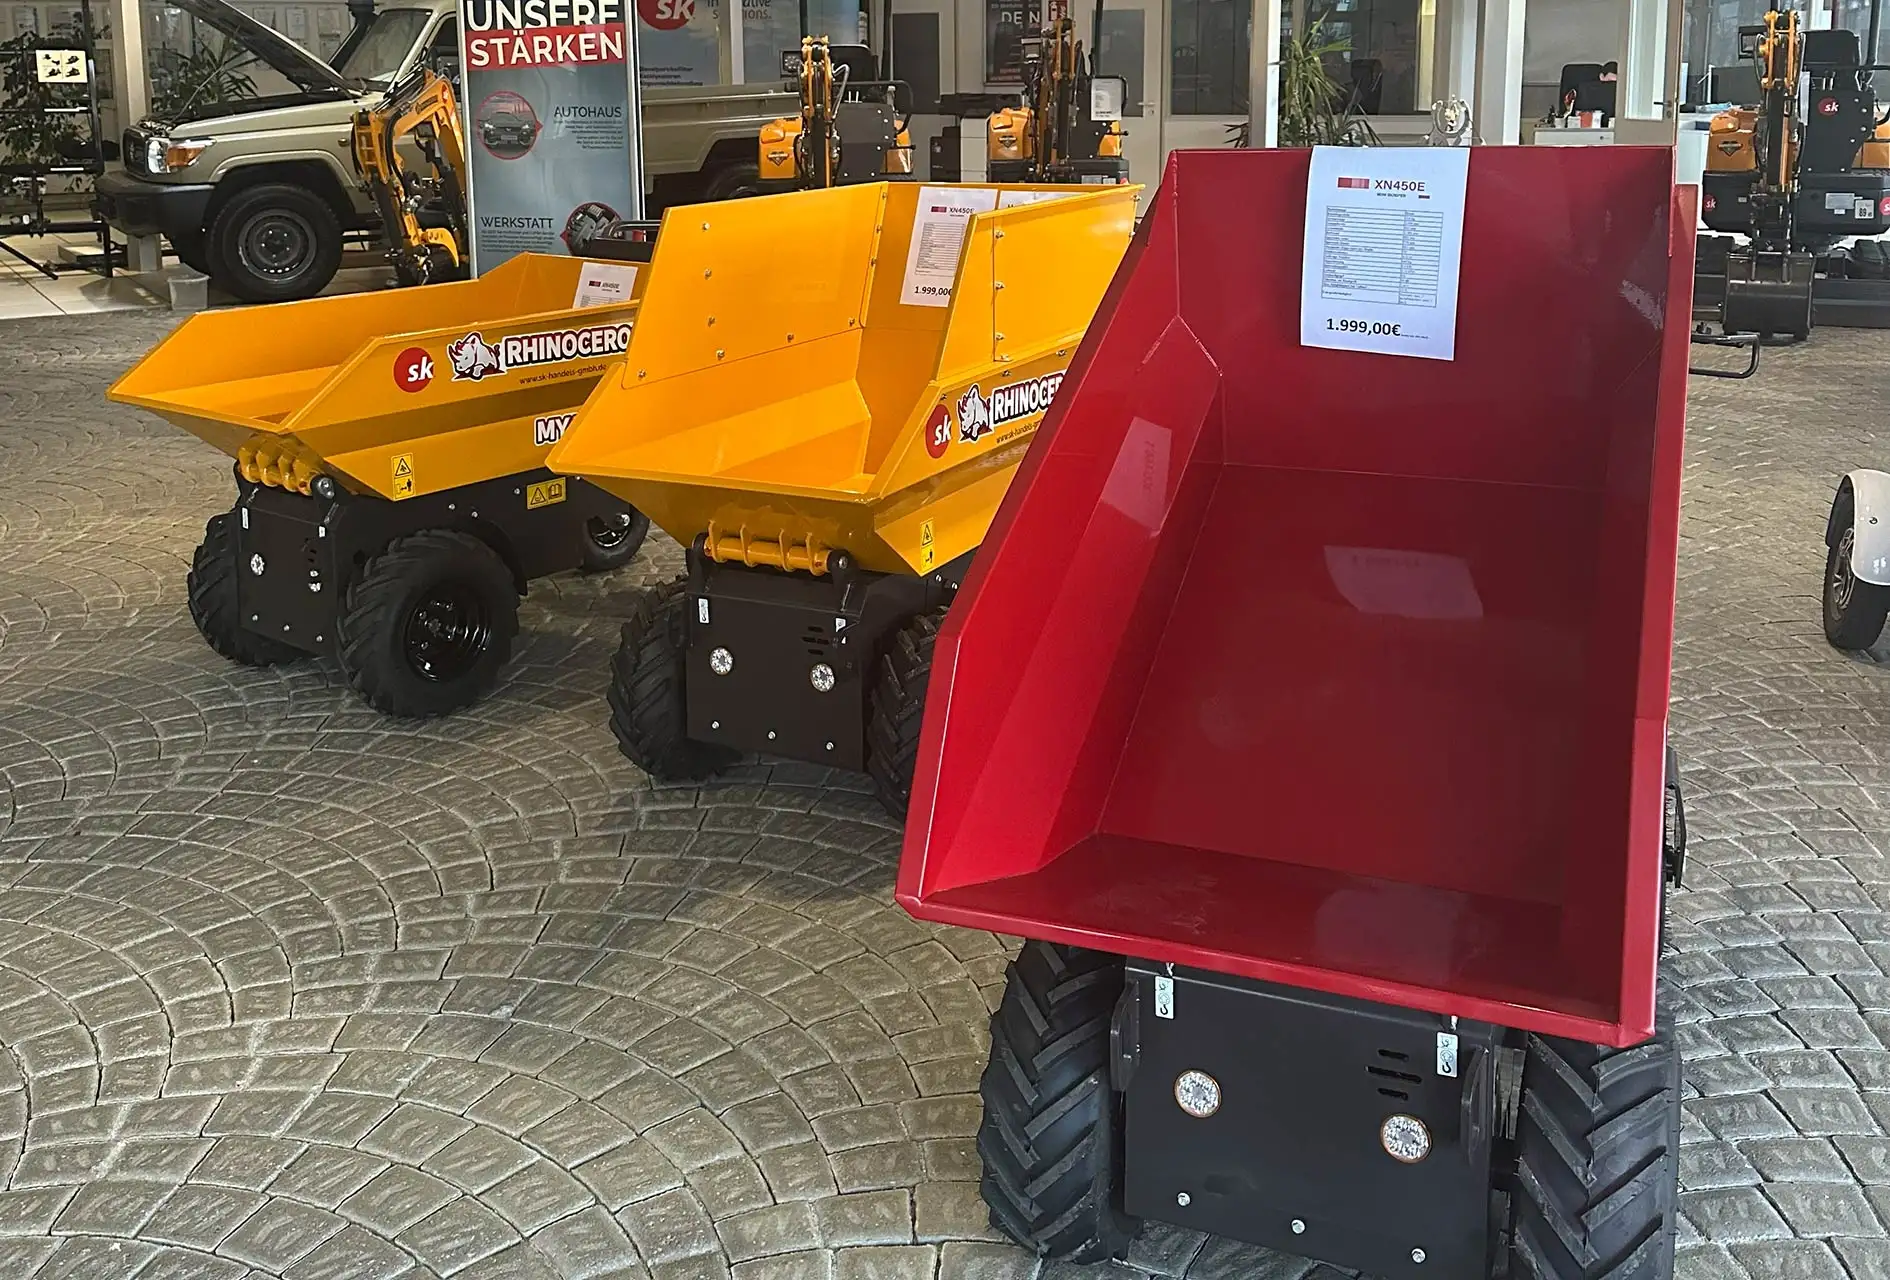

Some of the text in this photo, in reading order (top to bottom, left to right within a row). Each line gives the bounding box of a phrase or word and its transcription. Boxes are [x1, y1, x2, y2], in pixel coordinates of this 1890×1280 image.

[466, 0, 619, 31] UNSERE
[470, 30, 623, 66] STÄRKEN
[554, 106, 622, 118] AUTOHAUS
[1824, 102, 1839, 112] sk
[1374, 180, 1425, 192] XN450E
[480, 216, 554, 229] WERKSTATT
[1326, 318, 1401, 336] 1.999,00€
[407, 356, 435, 382] sk
[934, 414, 952, 446] sk
